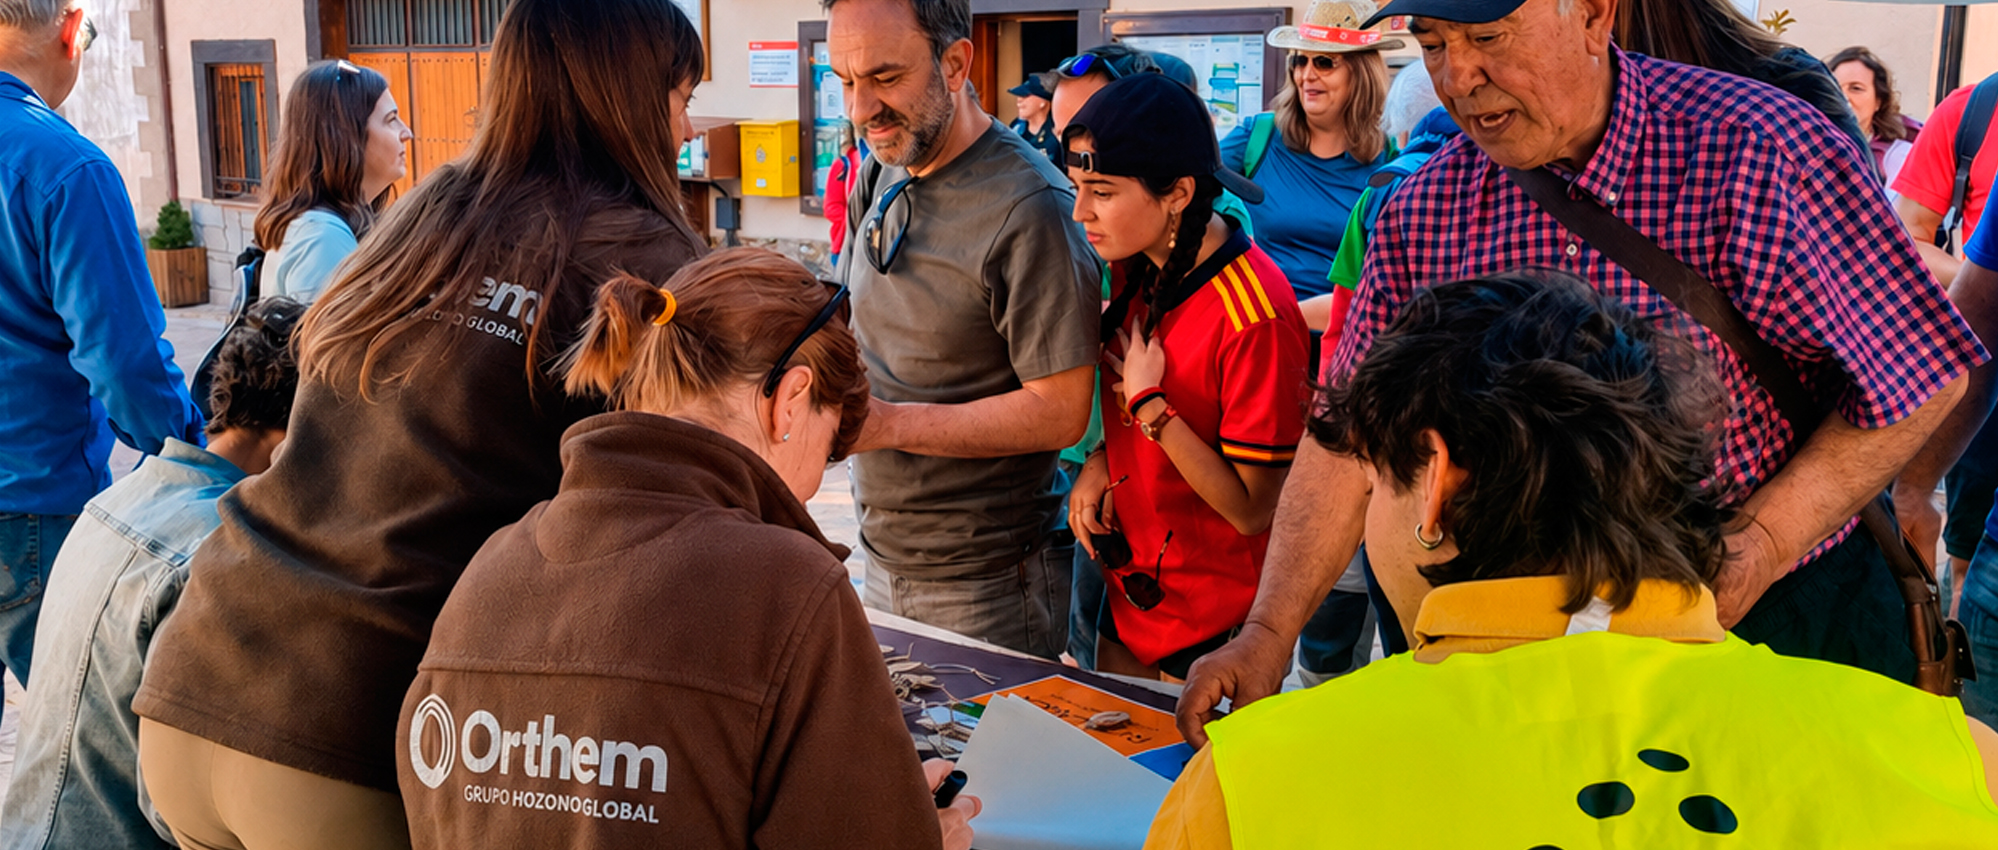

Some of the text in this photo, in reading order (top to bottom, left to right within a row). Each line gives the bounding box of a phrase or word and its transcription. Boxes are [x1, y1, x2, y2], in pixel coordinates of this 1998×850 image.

[461, 709, 669, 793] Orthem
[464, 784, 660, 824] GRUPO HOZONOGLOBAL
